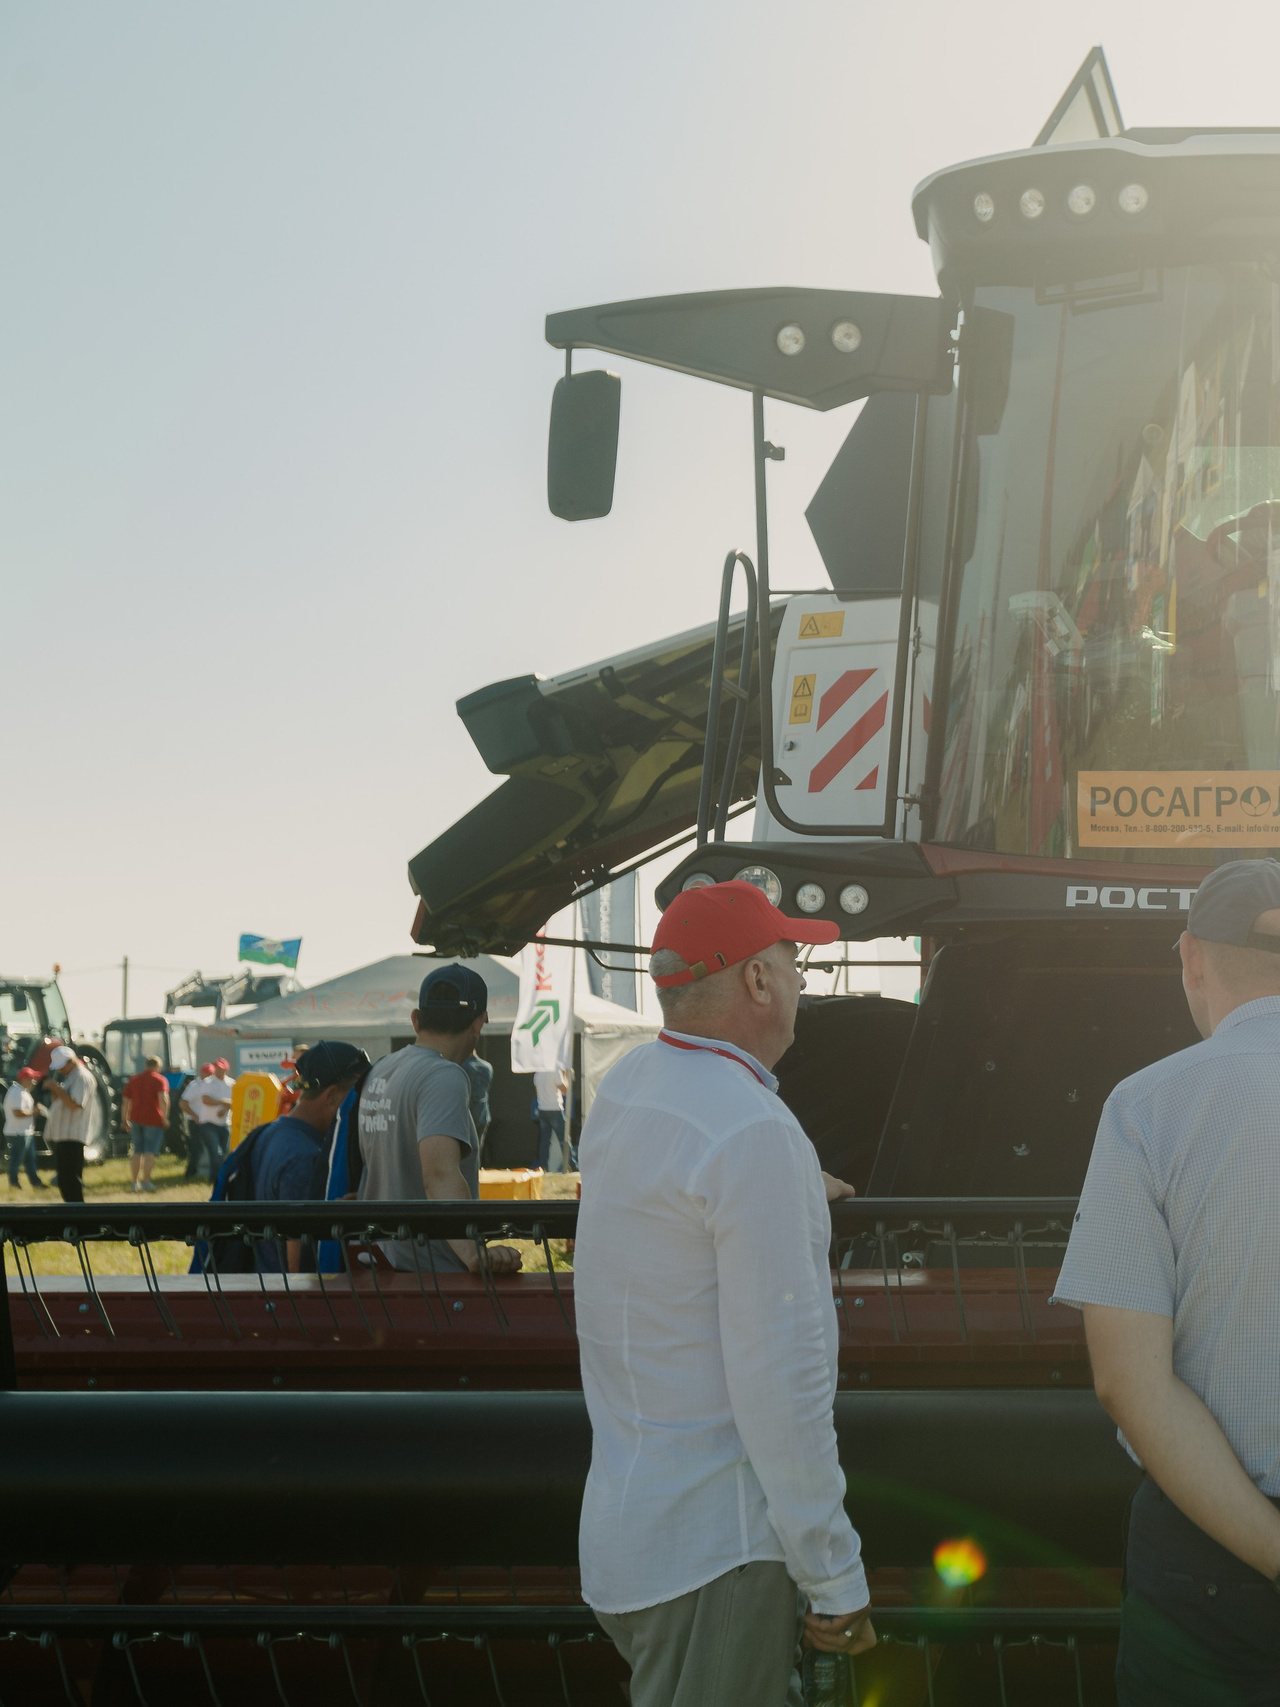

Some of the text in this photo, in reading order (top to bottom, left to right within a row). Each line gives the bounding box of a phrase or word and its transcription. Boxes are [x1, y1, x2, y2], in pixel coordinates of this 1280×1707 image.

[1090, 823, 1122, 833] Москва,
[1124, 823, 1143, 833] Тел.:
[1216, 824, 1244, 833] E-mail:
